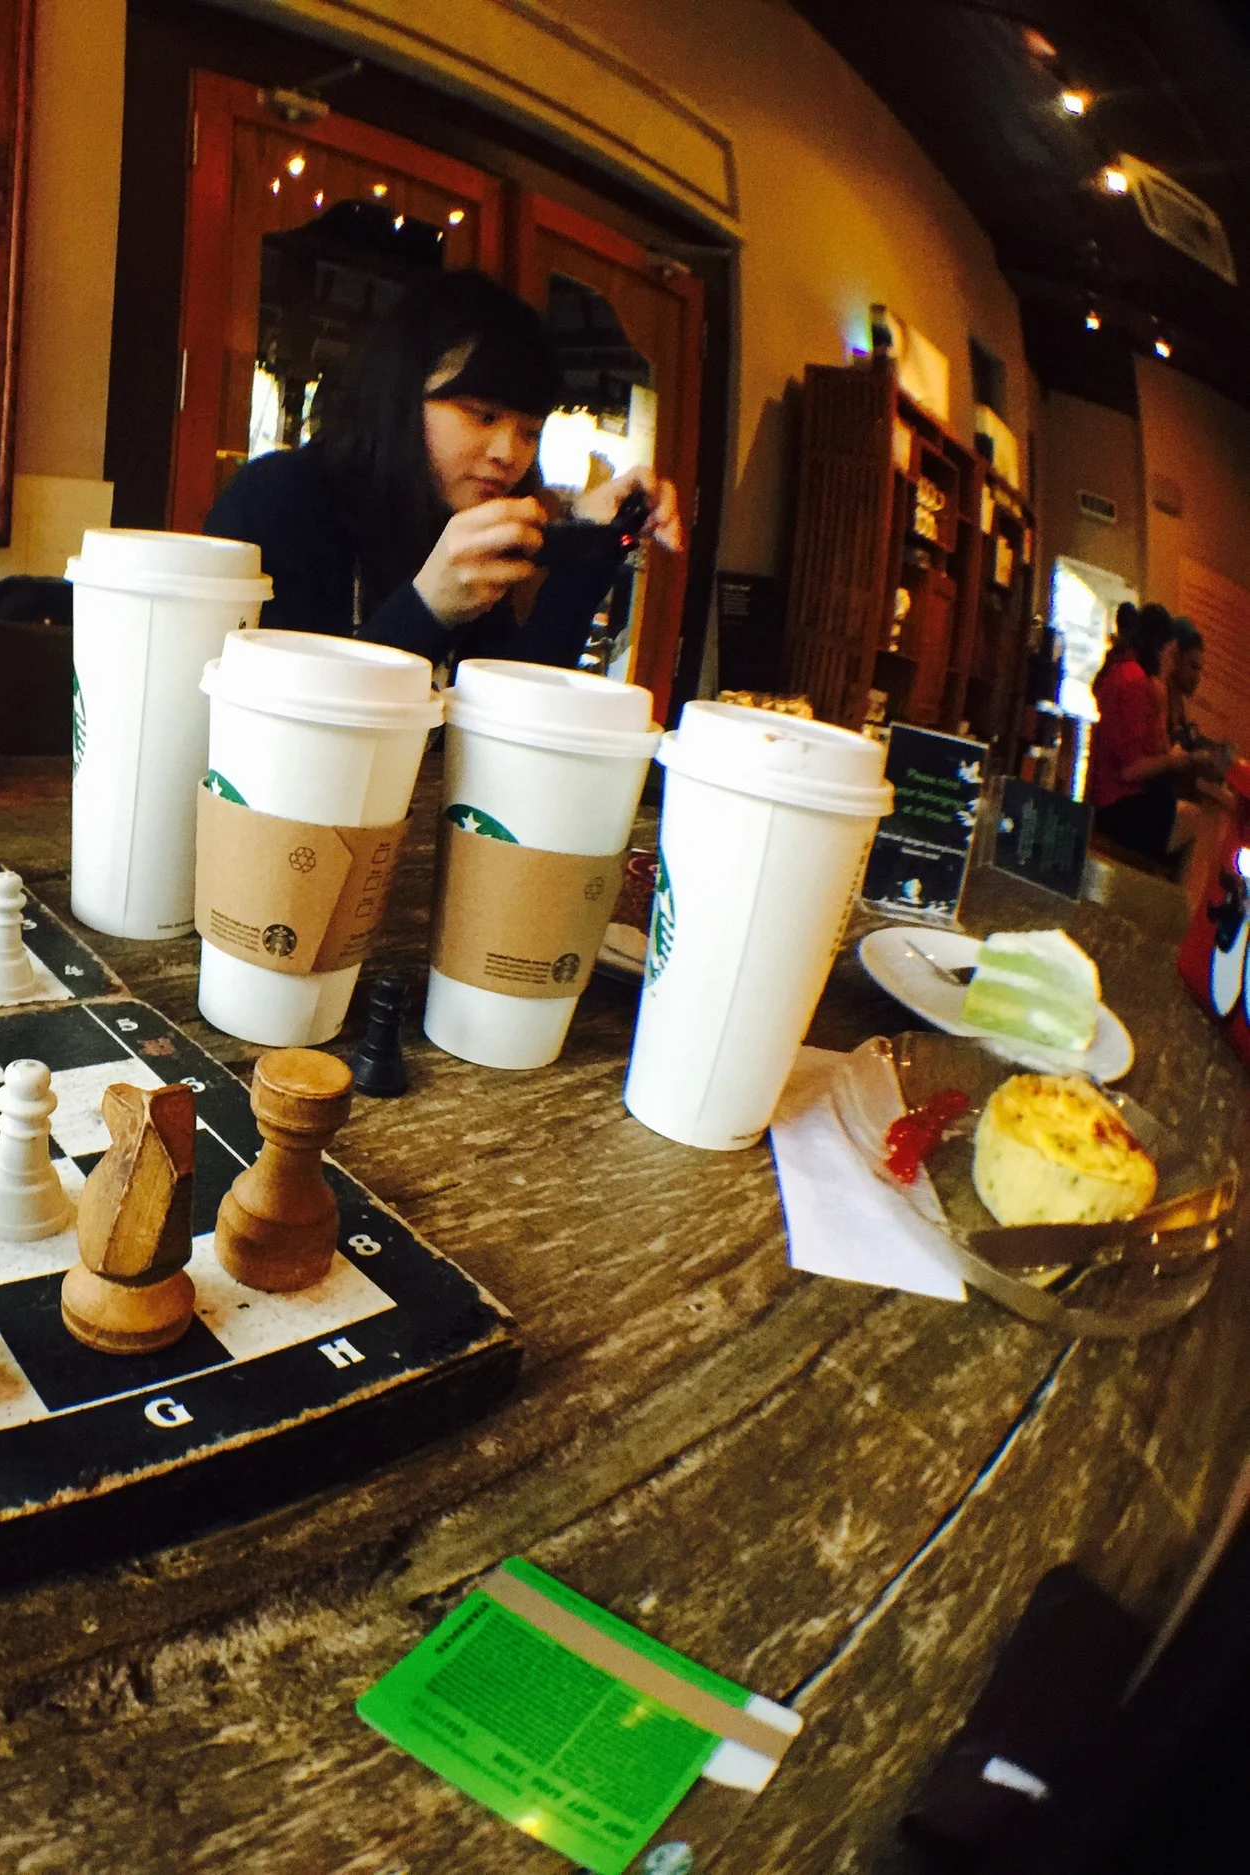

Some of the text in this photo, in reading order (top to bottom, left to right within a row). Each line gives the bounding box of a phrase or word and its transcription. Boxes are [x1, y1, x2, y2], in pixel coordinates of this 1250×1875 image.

[116, 1017, 139, 1032] 5
[348, 1234, 382, 1257] 8
[144, 1396, 194, 1428] G
[316, 1337, 365, 1368] H
